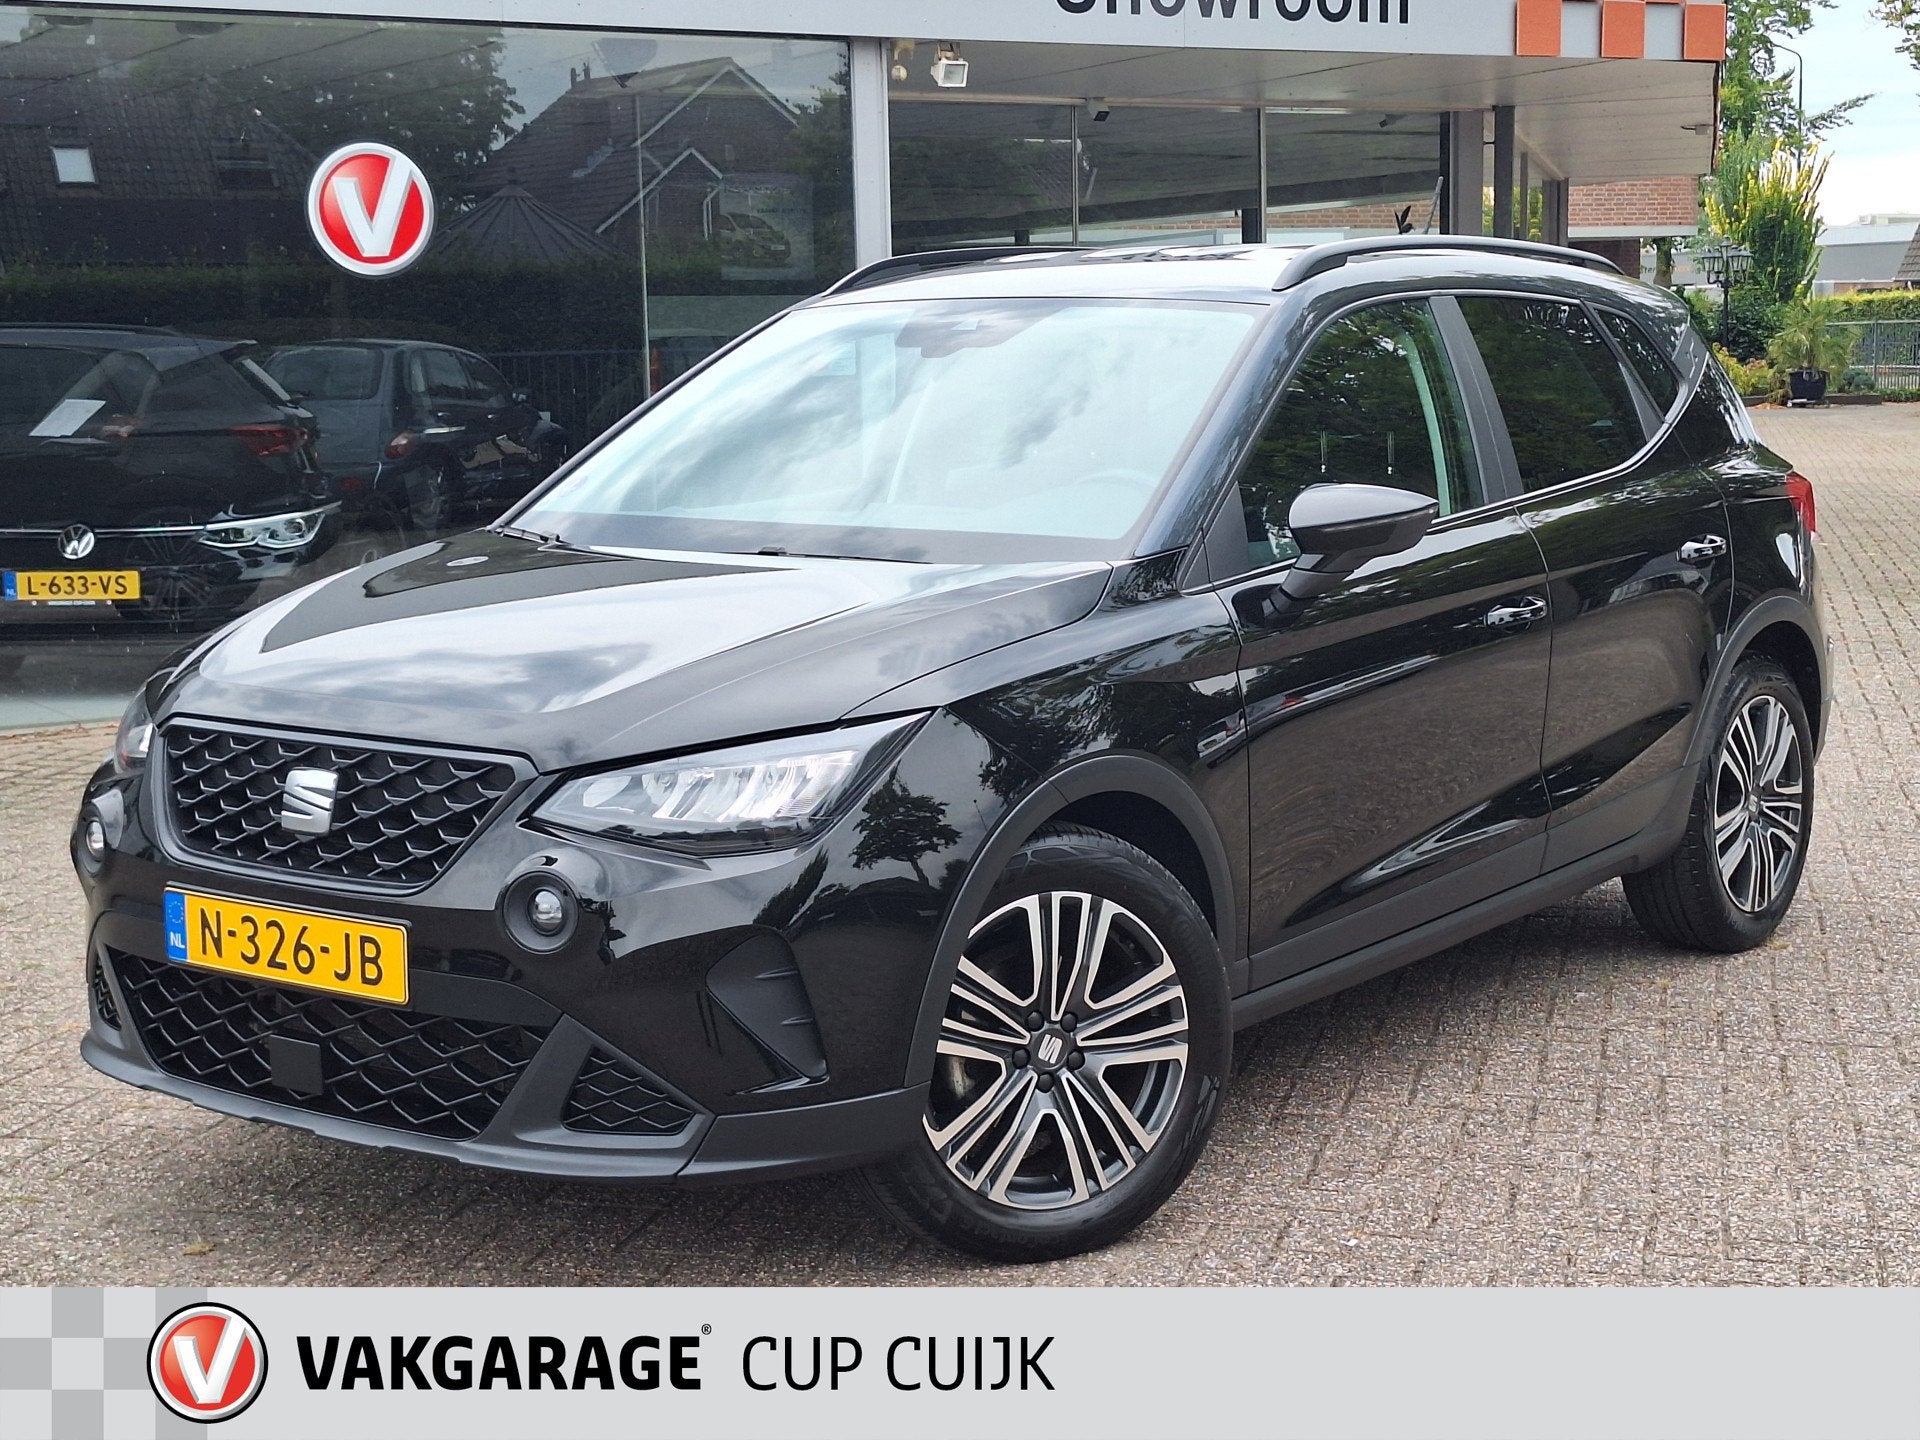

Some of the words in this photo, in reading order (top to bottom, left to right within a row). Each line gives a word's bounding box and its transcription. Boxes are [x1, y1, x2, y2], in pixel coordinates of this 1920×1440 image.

[1056, 0, 1409, 24] wroom
[27, 575, 128, 596] L-633-VS
[170, 931, 185, 949] NL
[199, 907, 384, 987] N-326-JB
